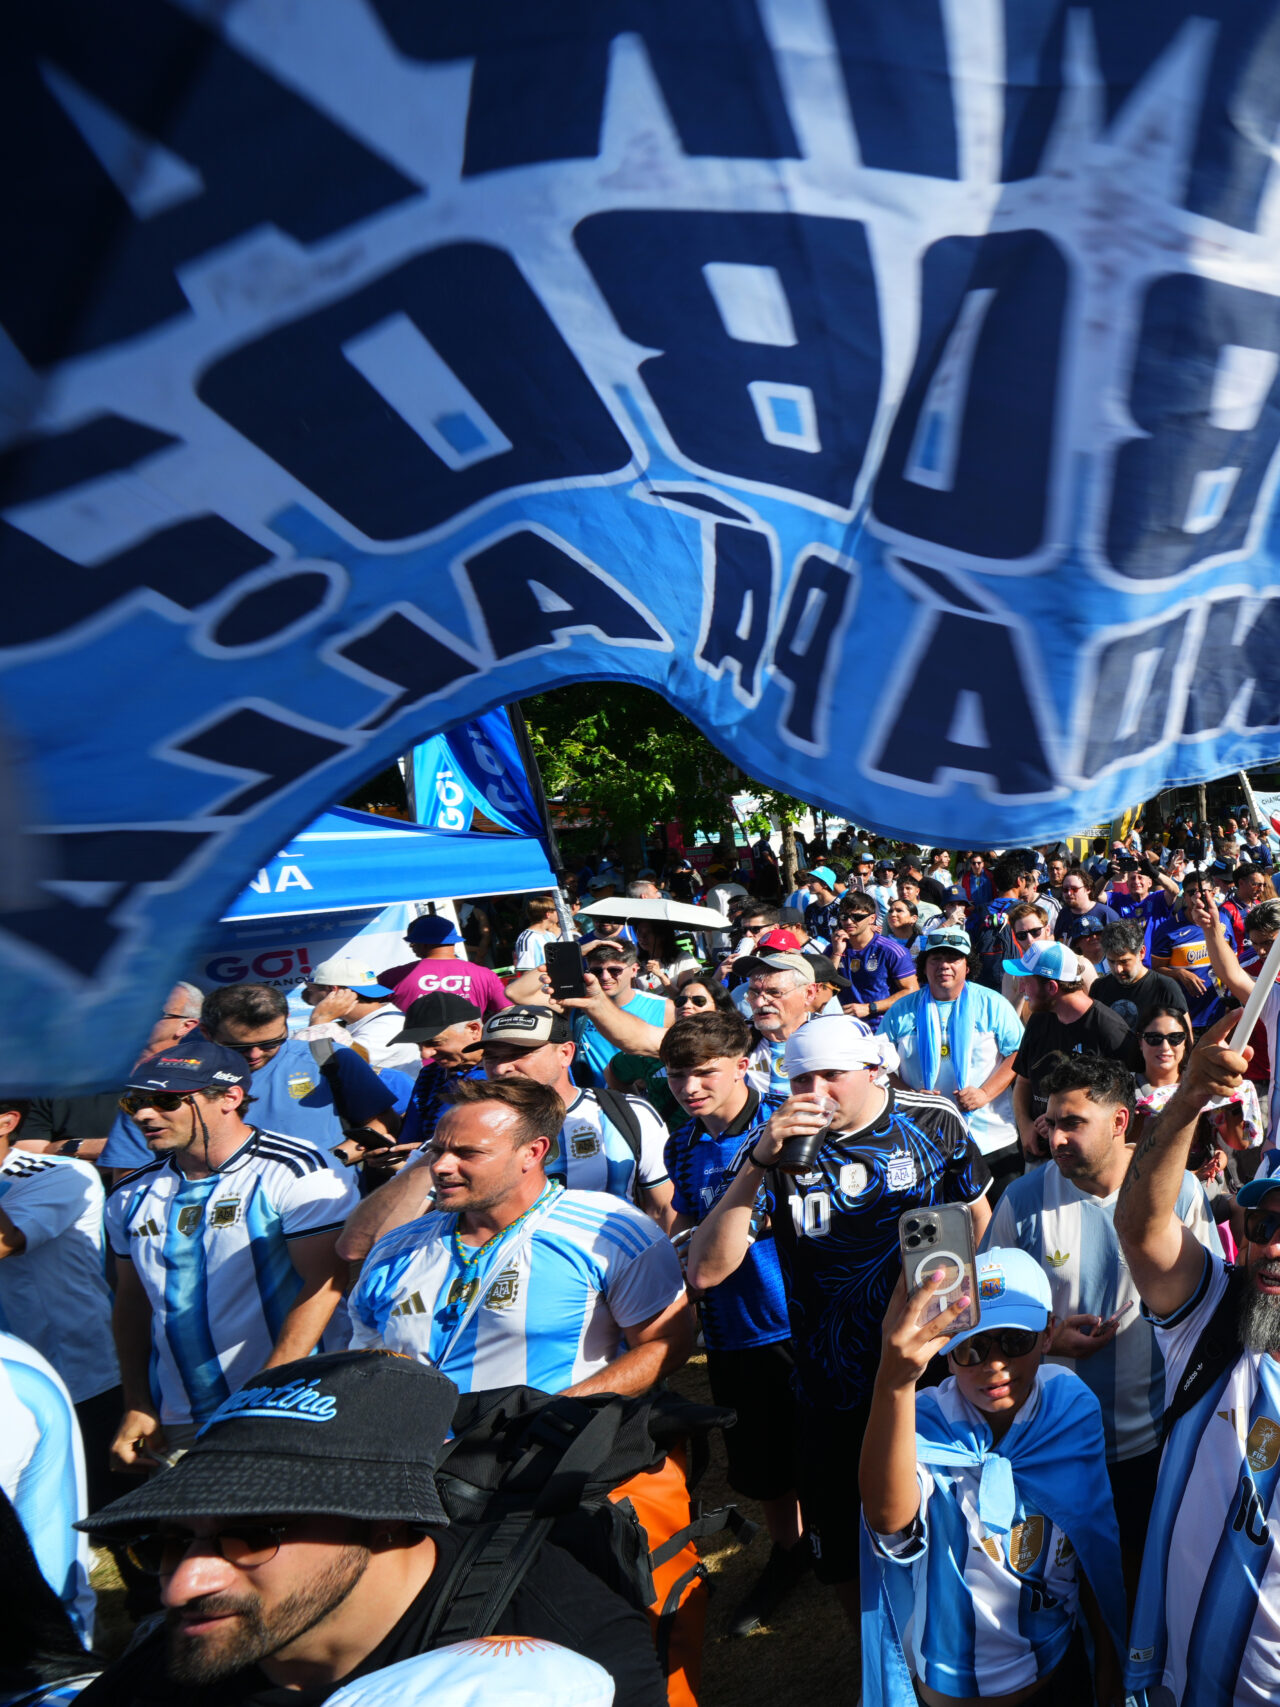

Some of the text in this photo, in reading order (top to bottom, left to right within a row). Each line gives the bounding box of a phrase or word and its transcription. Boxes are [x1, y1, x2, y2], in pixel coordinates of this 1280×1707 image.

[436, 770, 465, 831] GO!
[205, 947, 313, 984] GO!
[418, 974, 472, 992] GO!
[788, 1192, 830, 1238] 10
[1252, 1450, 1268, 1463] FIFA
[1232, 1476, 1270, 1546] 10
